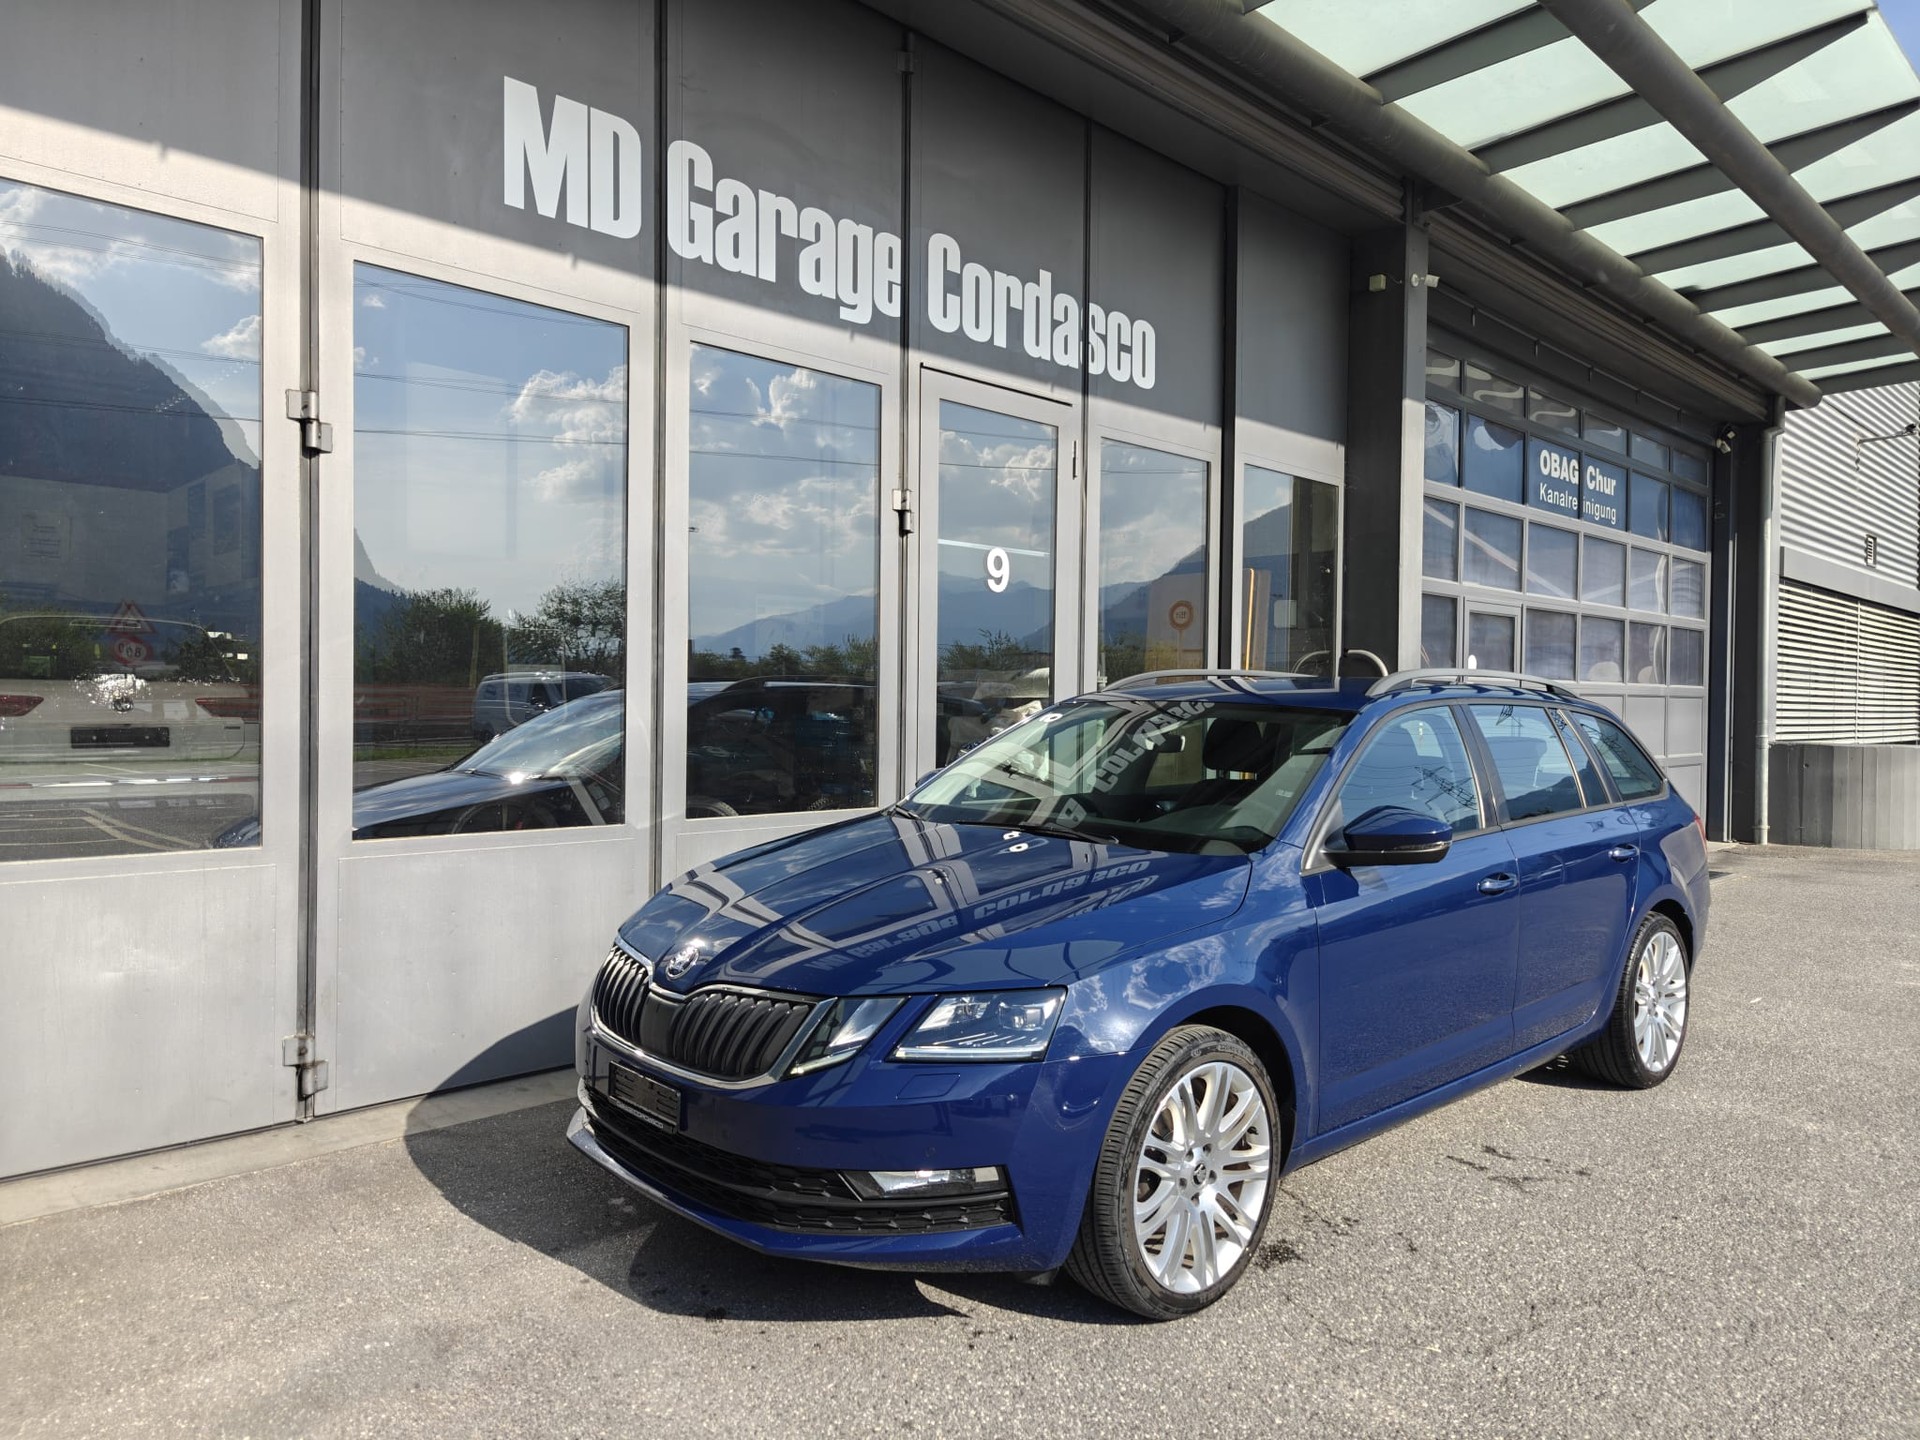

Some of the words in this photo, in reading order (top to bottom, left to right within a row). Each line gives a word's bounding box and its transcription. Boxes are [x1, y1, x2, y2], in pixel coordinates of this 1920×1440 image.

[504, 76, 642, 239] MD
[667, 140, 901, 324] Garage
[927, 233, 1156, 390] Cordasco
[1539, 449, 1579, 485] OBAG
[1586, 465, 1617, 496] Chur
[1539, 482, 1617, 525] Kanalreinigung
[986, 547, 1010, 593] 9
